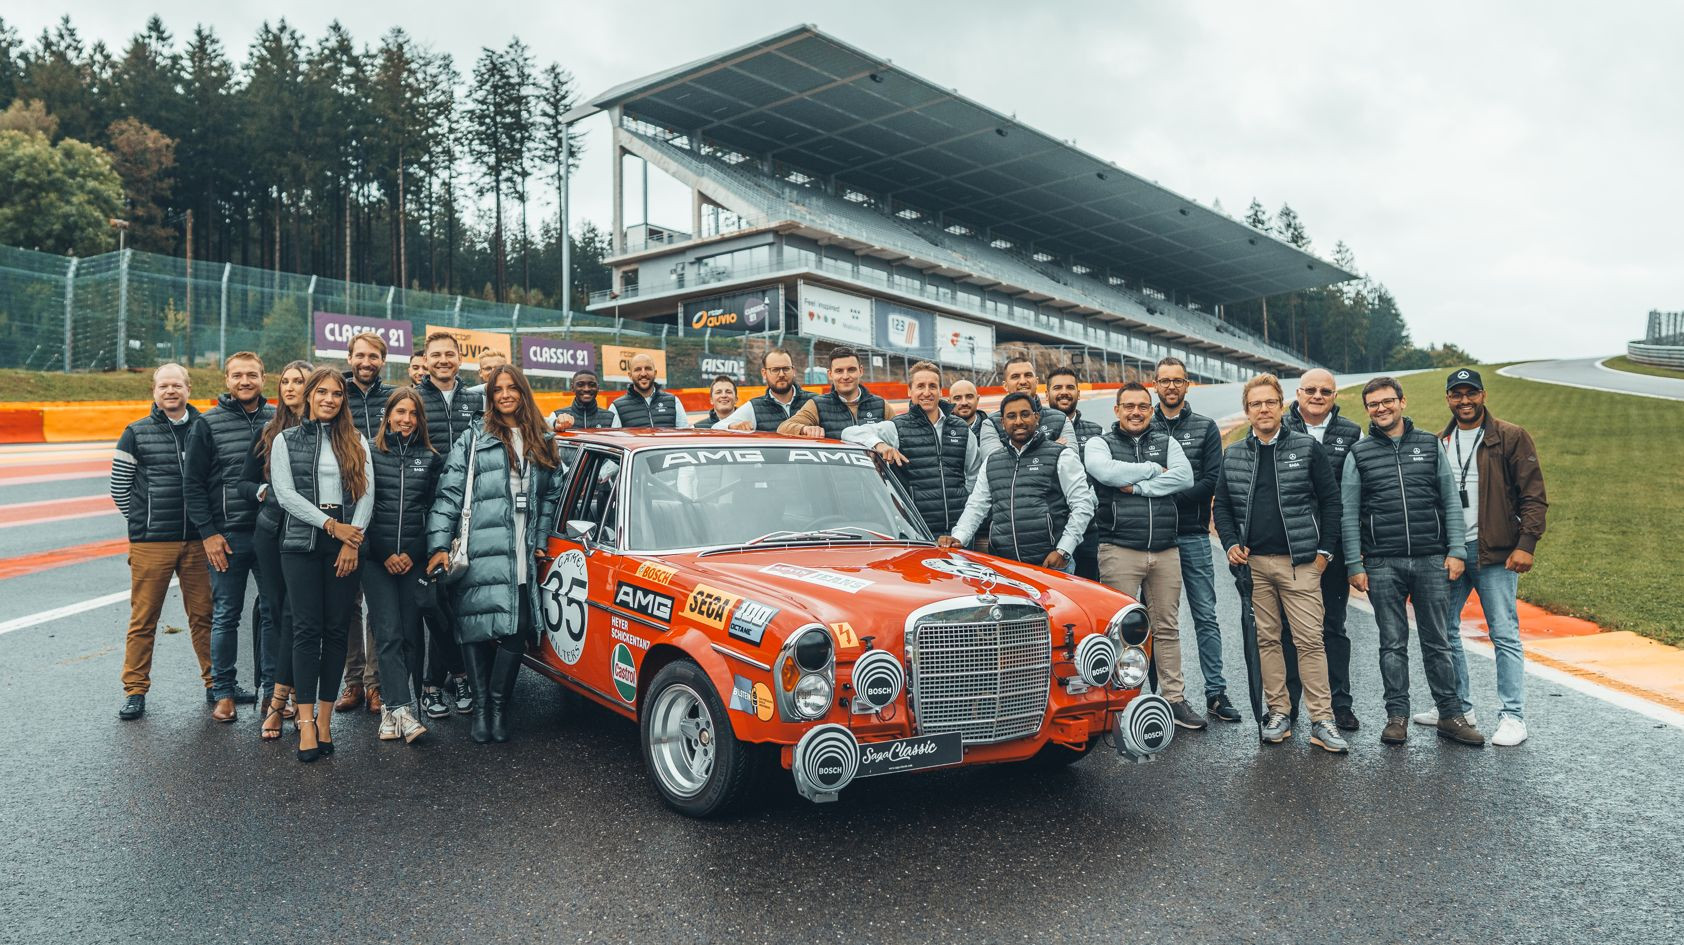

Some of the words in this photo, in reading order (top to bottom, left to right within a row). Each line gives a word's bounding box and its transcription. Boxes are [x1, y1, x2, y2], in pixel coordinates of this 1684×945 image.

[707, 312, 737, 327] auvio
[388, 328, 405, 348] 21
[460, 344, 490, 358] uvi
[529, 345, 575, 365] CLASSIC
[576, 349, 589, 366] 21
[701, 358, 739, 373] AISIN
[662, 450, 765, 469] AMG
[788, 450, 875, 468] AMG
[557, 552, 584, 576] CAMEL
[641, 566, 672, 585] BOSCH
[543, 570, 587, 642] 35
[615, 585, 673, 620] AMG
[611, 616, 629, 631] HEYER
[734, 600, 774, 628] 100
[730, 623, 753, 636] OCTANE
[550, 634, 581, 663] FILTERS
[611, 628, 651, 651] SCHICKENTANZ
[614, 662, 637, 685] Castrol
[1092, 666, 1110, 677] BOSCH
[867, 687, 892, 695] BOSCH
[1143, 730, 1164, 740] BOSCH
[818, 766, 843, 774] BOSCH
